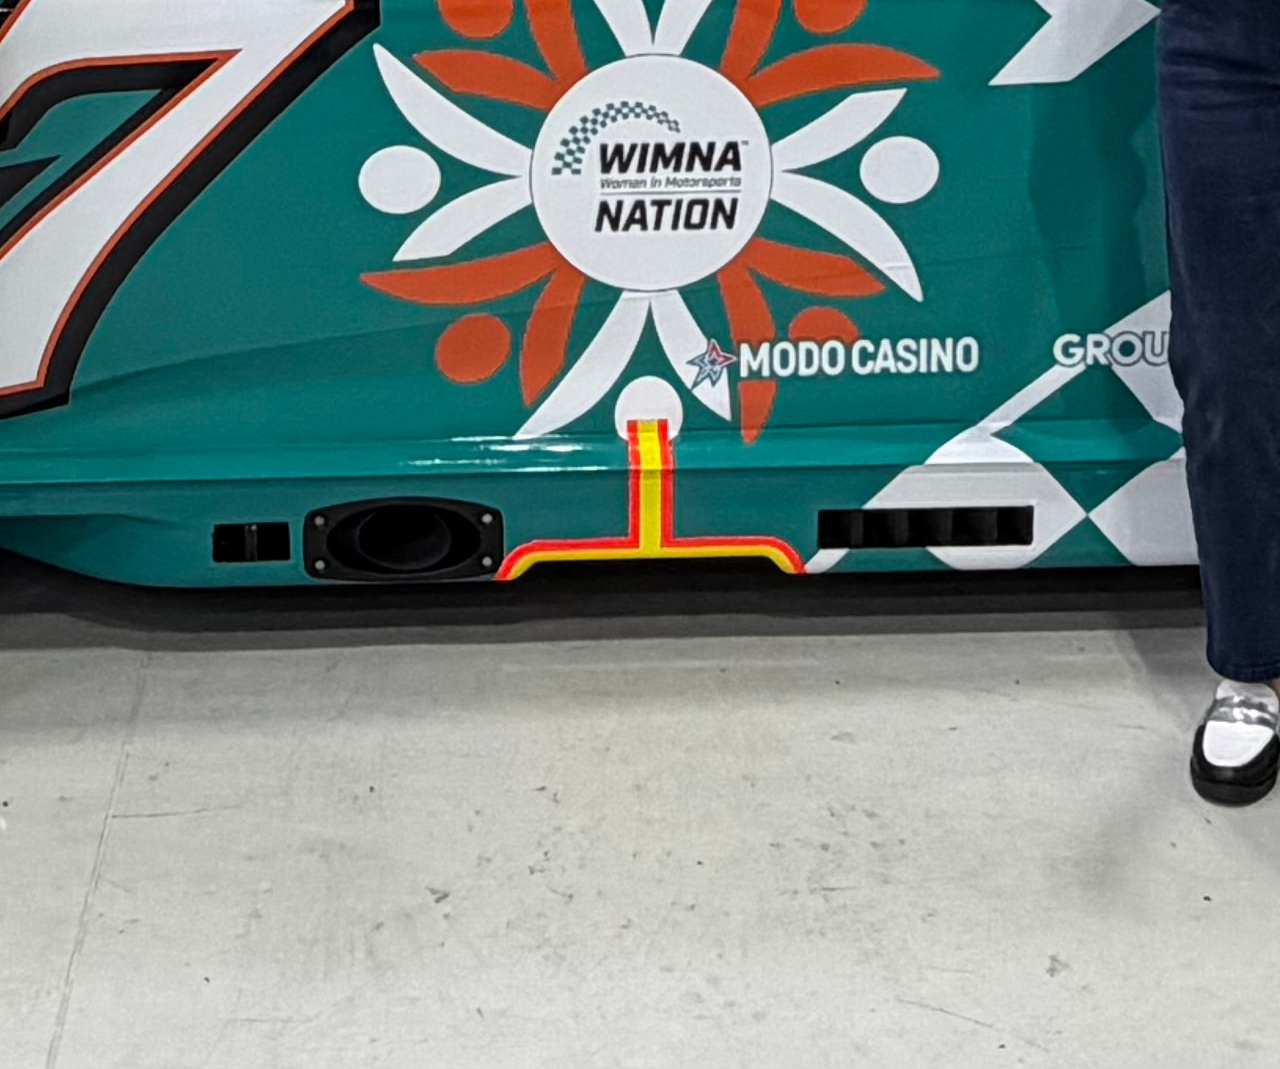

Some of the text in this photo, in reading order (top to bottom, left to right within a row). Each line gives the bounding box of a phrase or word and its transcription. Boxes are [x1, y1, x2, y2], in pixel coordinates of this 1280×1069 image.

[600, 140, 742, 175] WIMNA
[600, 175, 741, 193] Women in Motorsports
[594, 198, 739, 233] NATION
[739, 336, 980, 377] MODO CASINO
[1053, 331, 1169, 369] GROU
